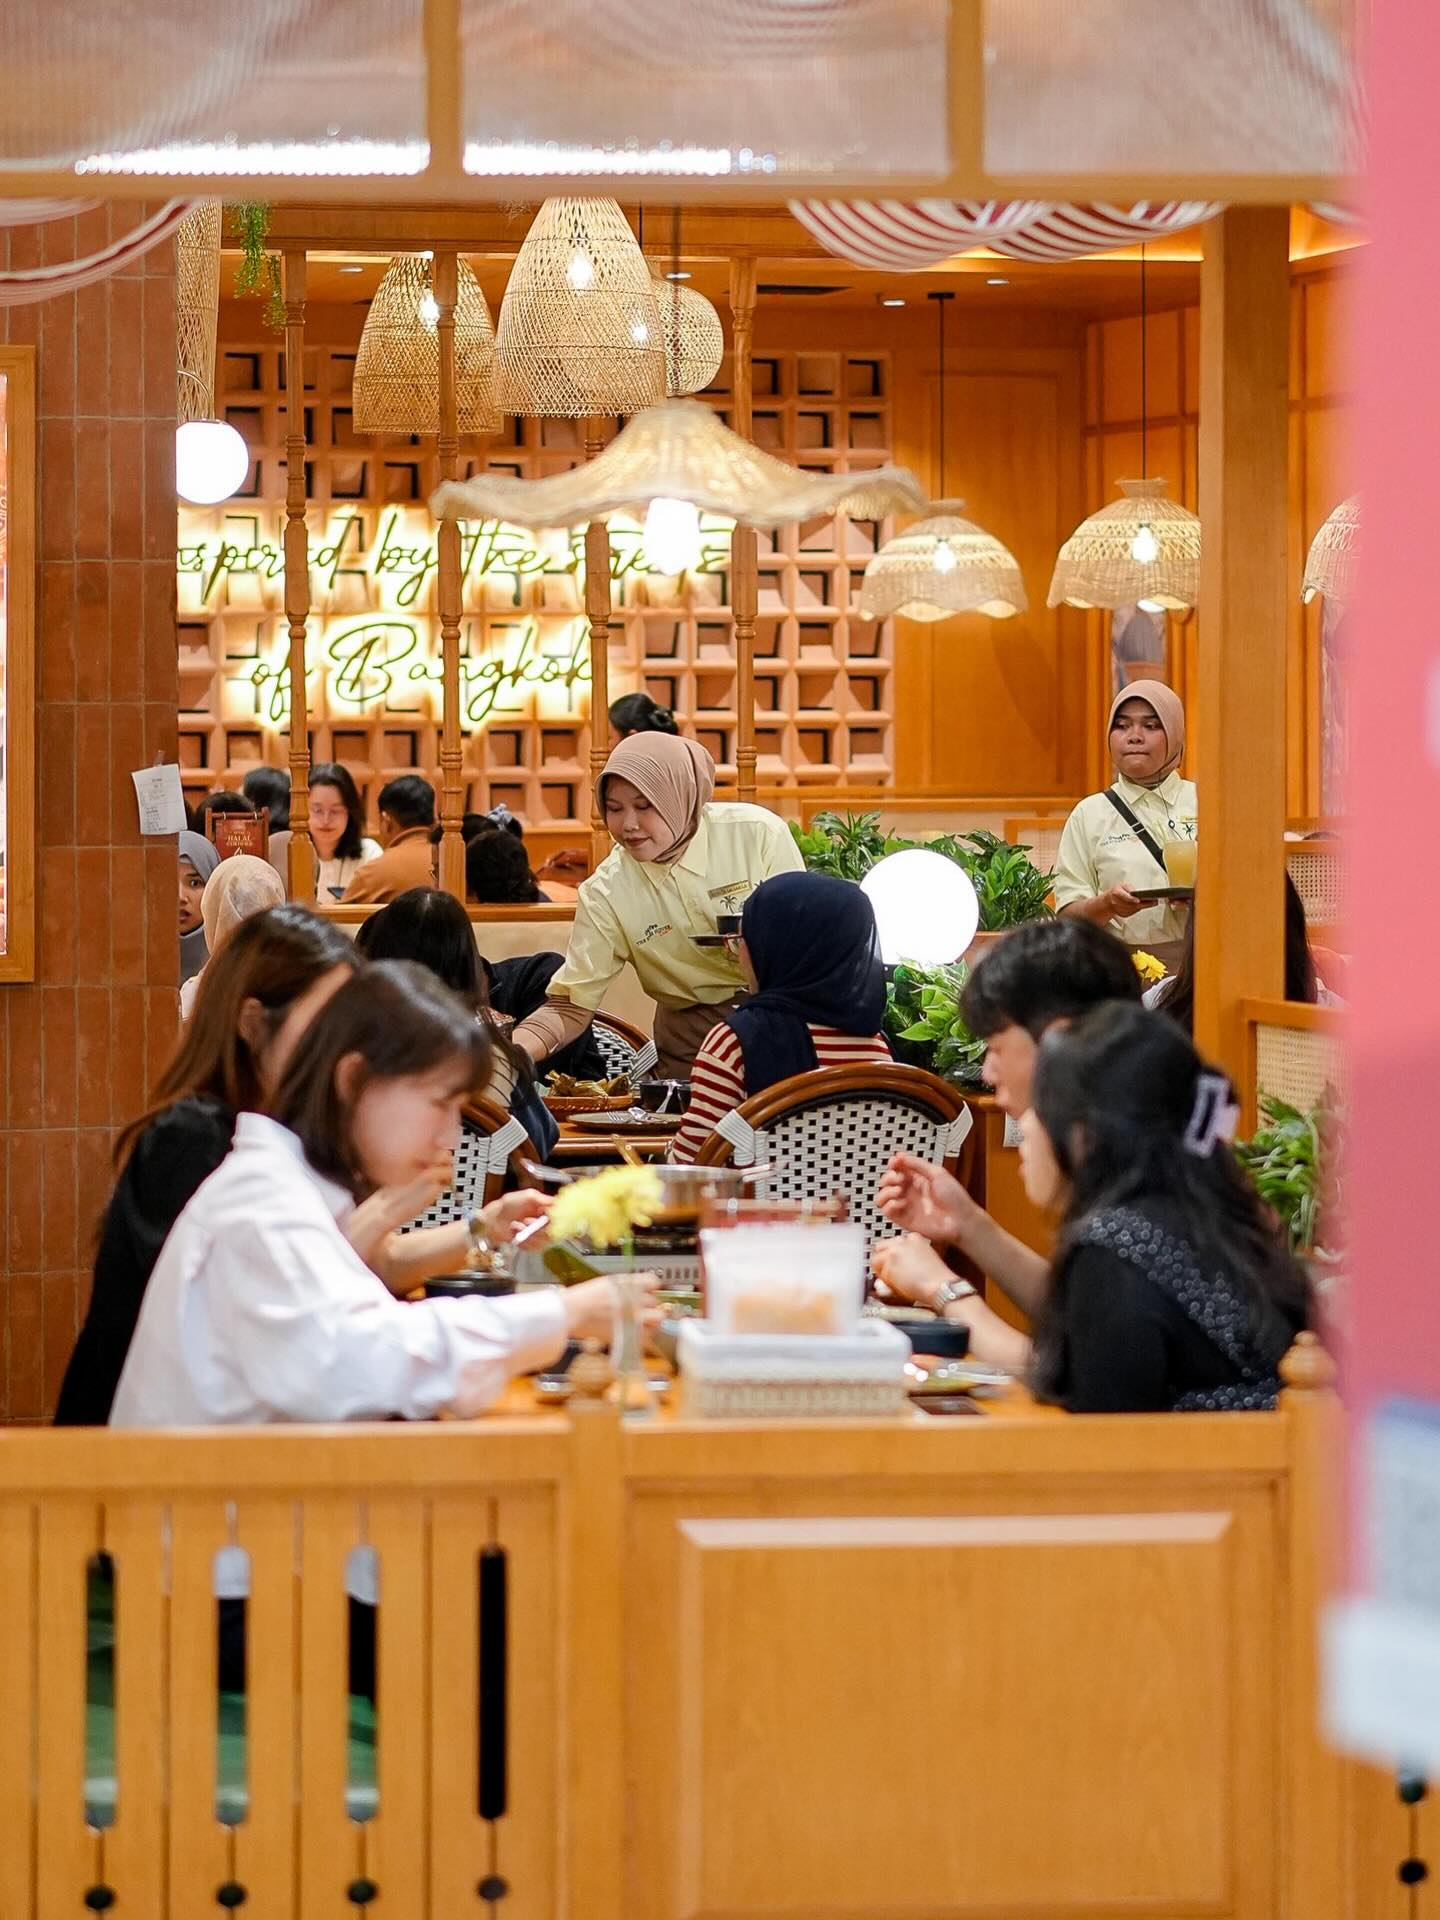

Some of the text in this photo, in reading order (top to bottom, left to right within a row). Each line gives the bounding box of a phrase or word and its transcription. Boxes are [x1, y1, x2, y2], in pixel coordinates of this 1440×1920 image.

[375, 513, 438, 606] by
[460, 518, 551, 588] the
[251, 622, 592, 721] of Bangkok
